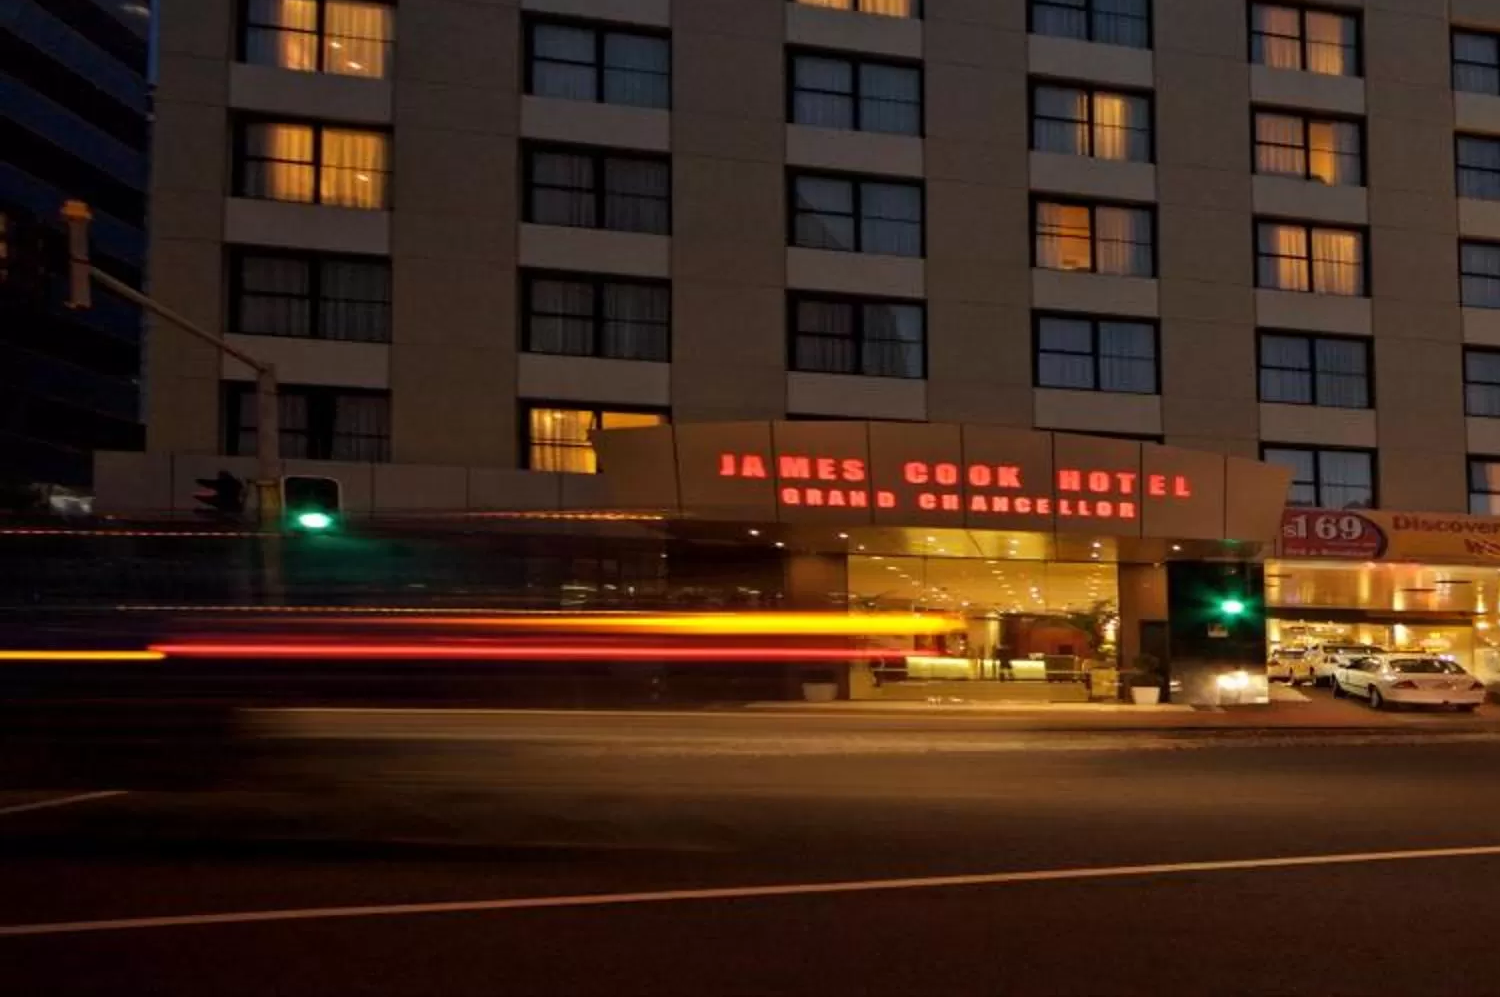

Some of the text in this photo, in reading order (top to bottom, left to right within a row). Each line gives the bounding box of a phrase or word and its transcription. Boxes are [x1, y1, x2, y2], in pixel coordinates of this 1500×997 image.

[720, 454, 1191, 497] JAMES COOK HOTEL
[780, 487, 1136, 519] GRAND CHANCELLOR
